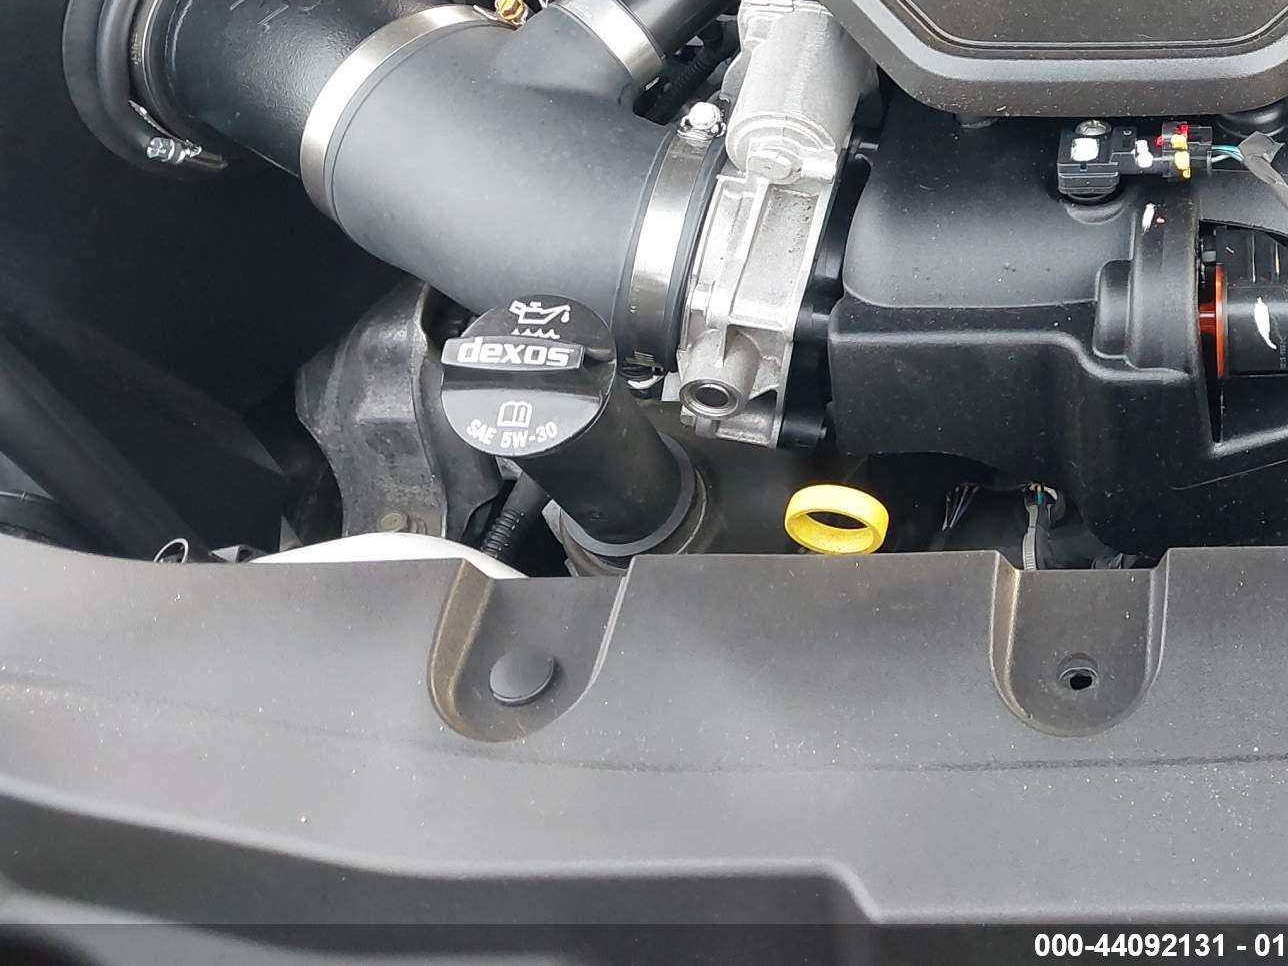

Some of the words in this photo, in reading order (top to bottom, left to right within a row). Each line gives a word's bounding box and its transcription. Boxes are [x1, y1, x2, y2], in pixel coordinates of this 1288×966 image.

[457, 336, 571, 367] dexos
[466, 419, 497, 446] SAE
[500, 421, 559, 449] 5W-30
